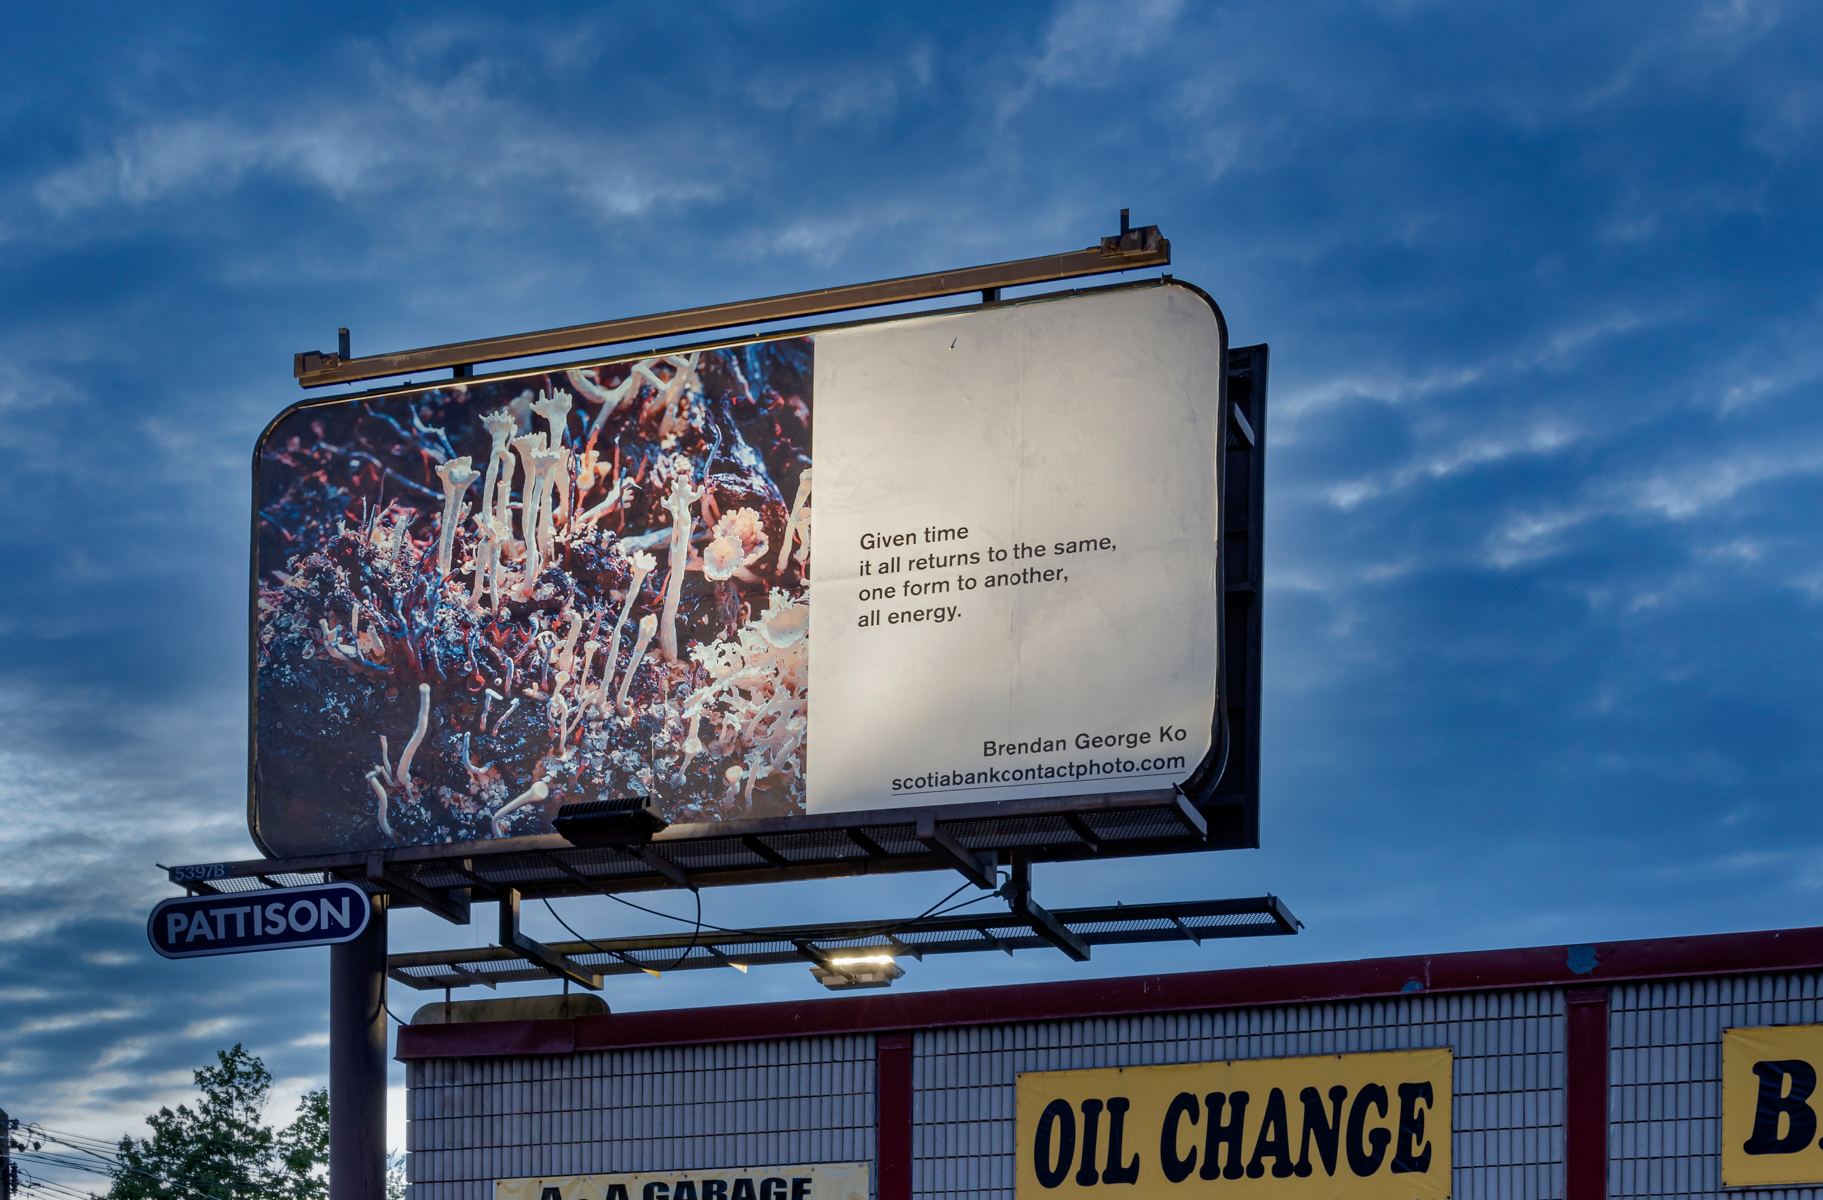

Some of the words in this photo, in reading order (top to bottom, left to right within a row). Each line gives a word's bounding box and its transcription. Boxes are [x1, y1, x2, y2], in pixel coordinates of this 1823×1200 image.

[859, 560, 872, 577] it
[877, 556, 901, 575] all
[908, 551, 981, 573] returns
[987, 546, 1008, 563] to
[1013, 542, 1046, 561] the
[1054, 533, 1118, 556] same,
[860, 532, 917, 551] Given
[924, 524, 969, 546] time
[858, 584, 896, 602] one
[902, 577, 951, 598] form
[957, 573, 977, 591] to
[984, 564, 1069, 589] another,
[857, 610, 881, 628] all
[887, 603, 962, 626] energy.
[983, 737, 1067, 758] Brendan
[1074, 730, 1152, 751] George
[1159, 726, 1188, 744] Ko
[891, 753, 1186, 791] scotiabankcontactphoto.com
[174, 863, 225, 881] 5397B
[166, 897, 350, 944] PATTISON
[1033, 1096, 1140, 1189] OIL
[1160, 1080, 1434, 1183] CHANGE
